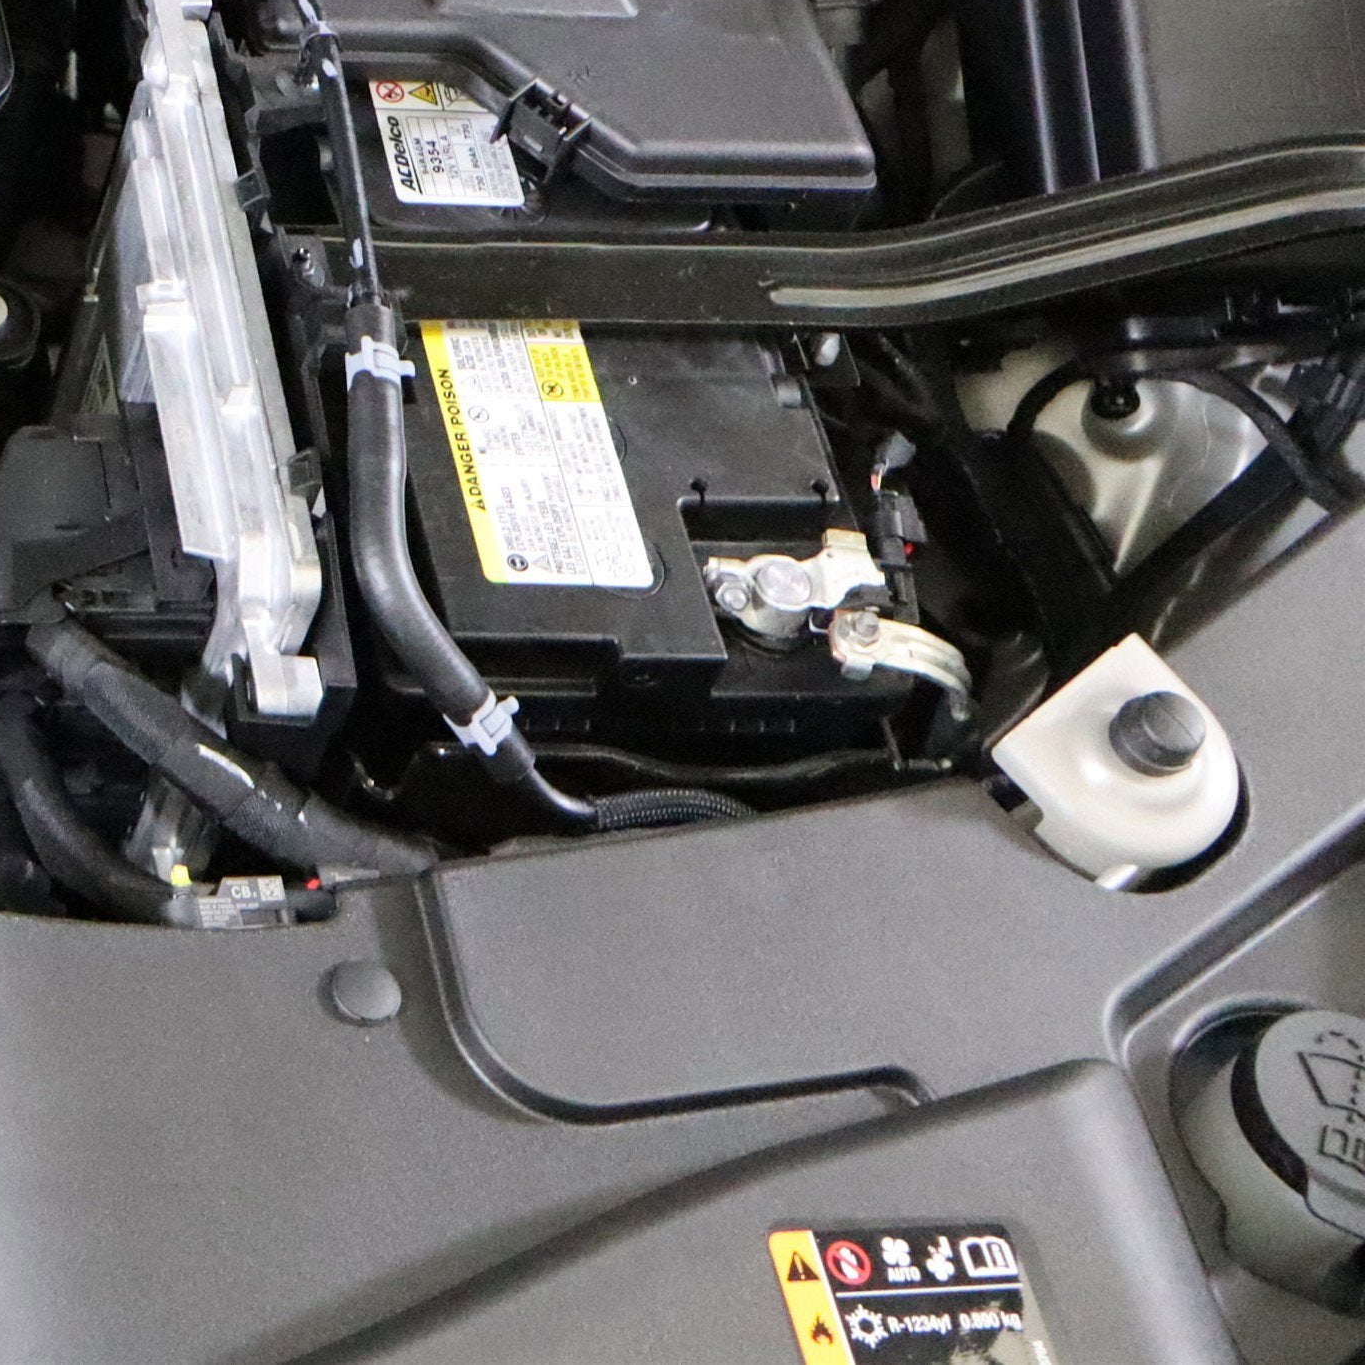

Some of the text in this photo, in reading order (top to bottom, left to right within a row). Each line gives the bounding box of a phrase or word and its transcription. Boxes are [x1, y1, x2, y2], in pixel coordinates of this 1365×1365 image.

[387, 116, 416, 191] ACDelco
[426, 140, 444, 174] 9354
[887, 1265, 922, 1283] AUTO
[1001, 1310, 1023, 1332] kg
